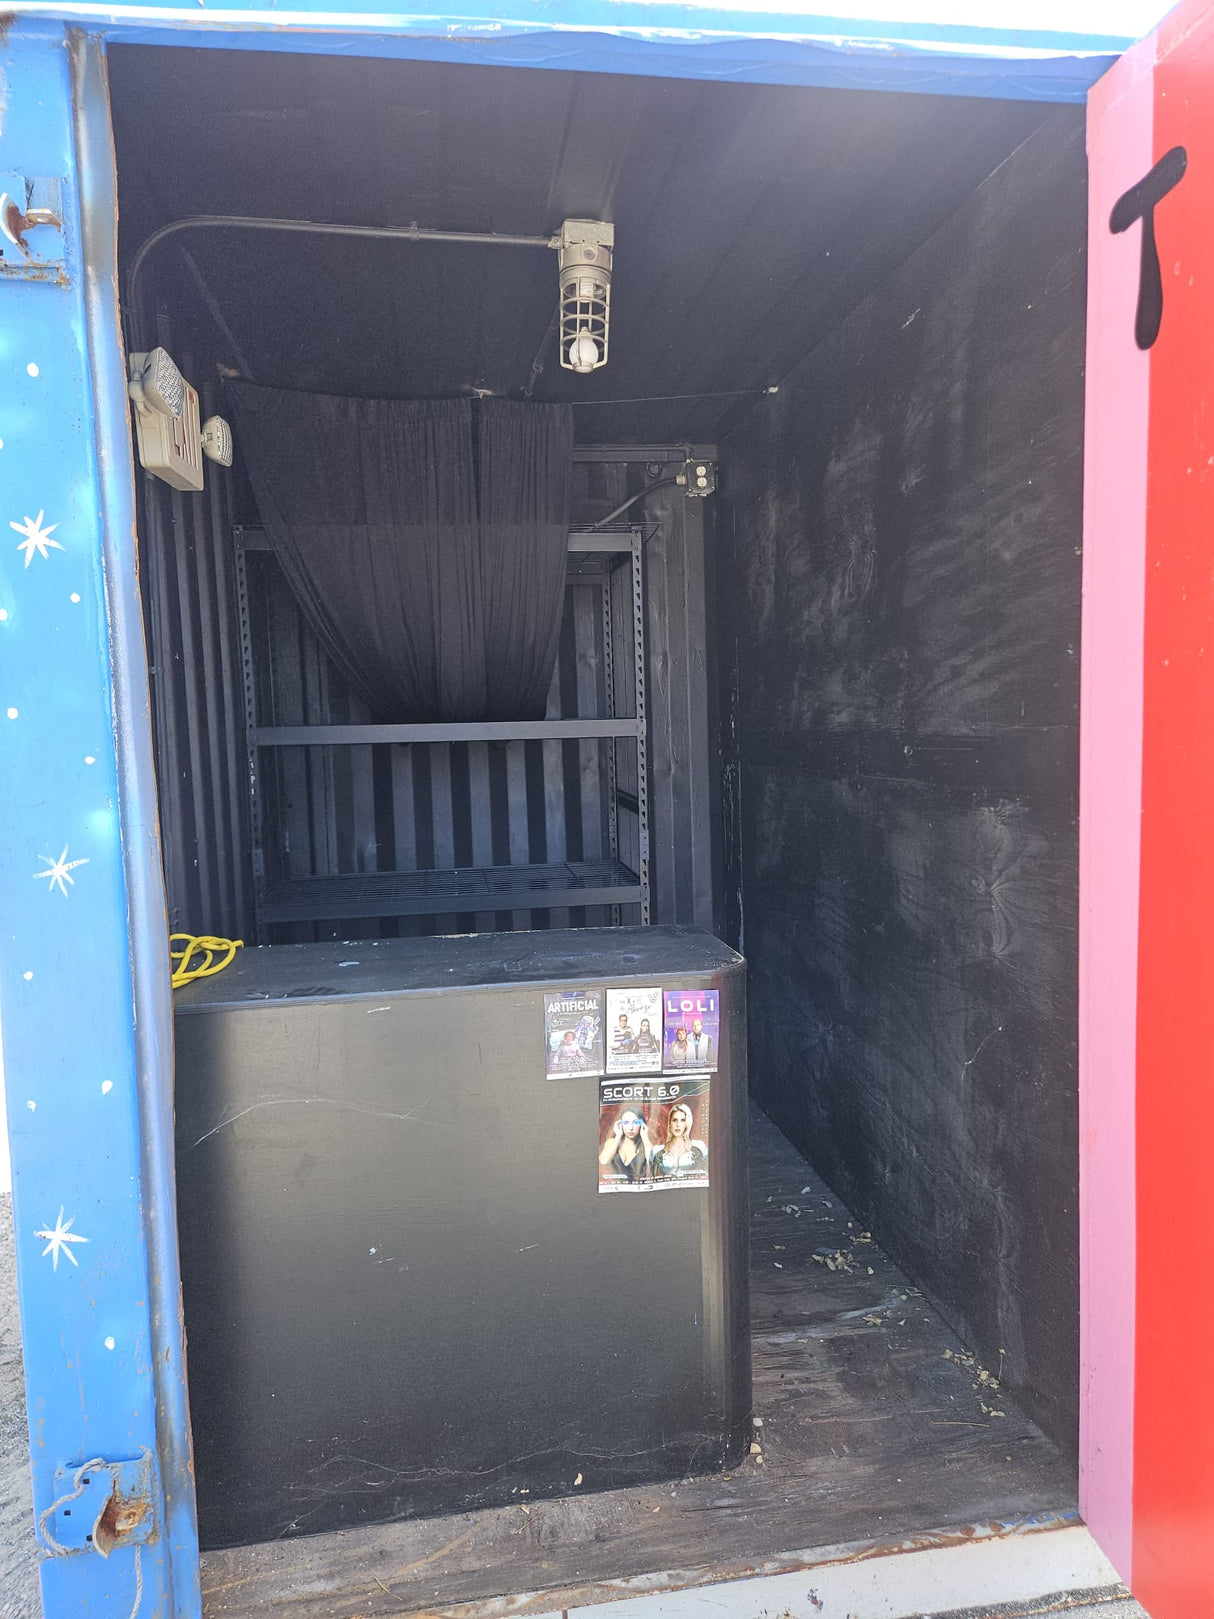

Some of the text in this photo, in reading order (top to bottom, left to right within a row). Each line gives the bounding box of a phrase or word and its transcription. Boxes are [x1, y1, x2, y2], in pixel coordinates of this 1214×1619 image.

[1109, 145, 1187, 350] T
[547, 999, 599, 1013] ARTIFICIAL
[667, 999, 714, 1012] LOLI
[603, 1085, 680, 1098] SCORT 6.0
